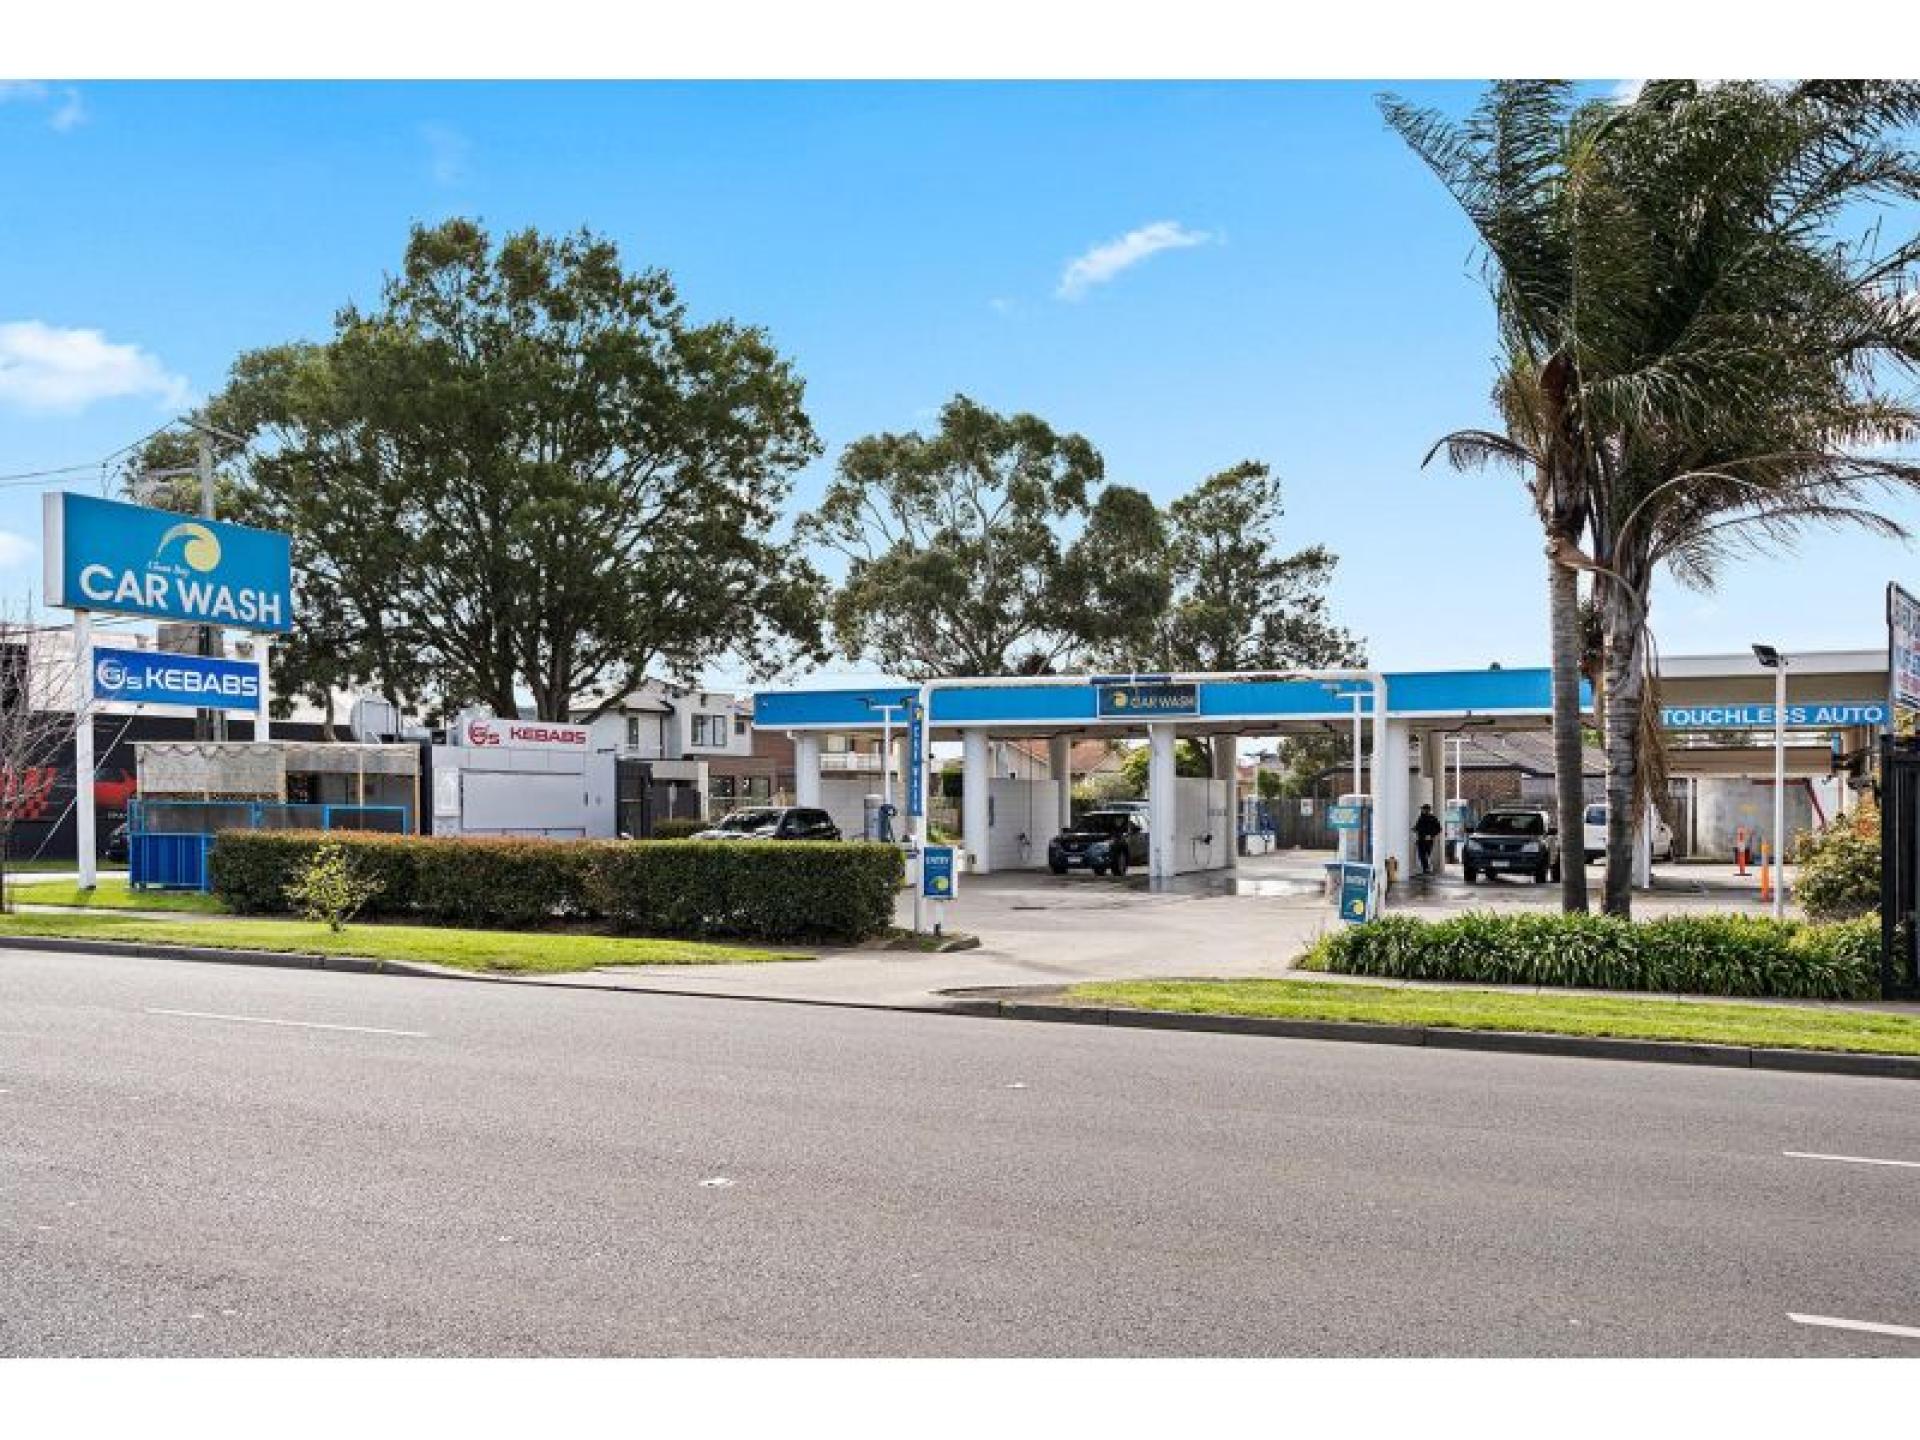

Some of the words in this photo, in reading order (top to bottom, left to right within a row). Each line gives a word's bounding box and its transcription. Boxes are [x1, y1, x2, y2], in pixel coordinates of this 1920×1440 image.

[79, 563, 169, 610] CAR
[176, 578, 282, 625] WASH
[145, 666, 258, 697] KEBABS
[1661, 707, 1806, 726] TOUCHLES
[1815, 706, 1883, 724] AUTO
[510, 726, 587, 745] KEBABS
